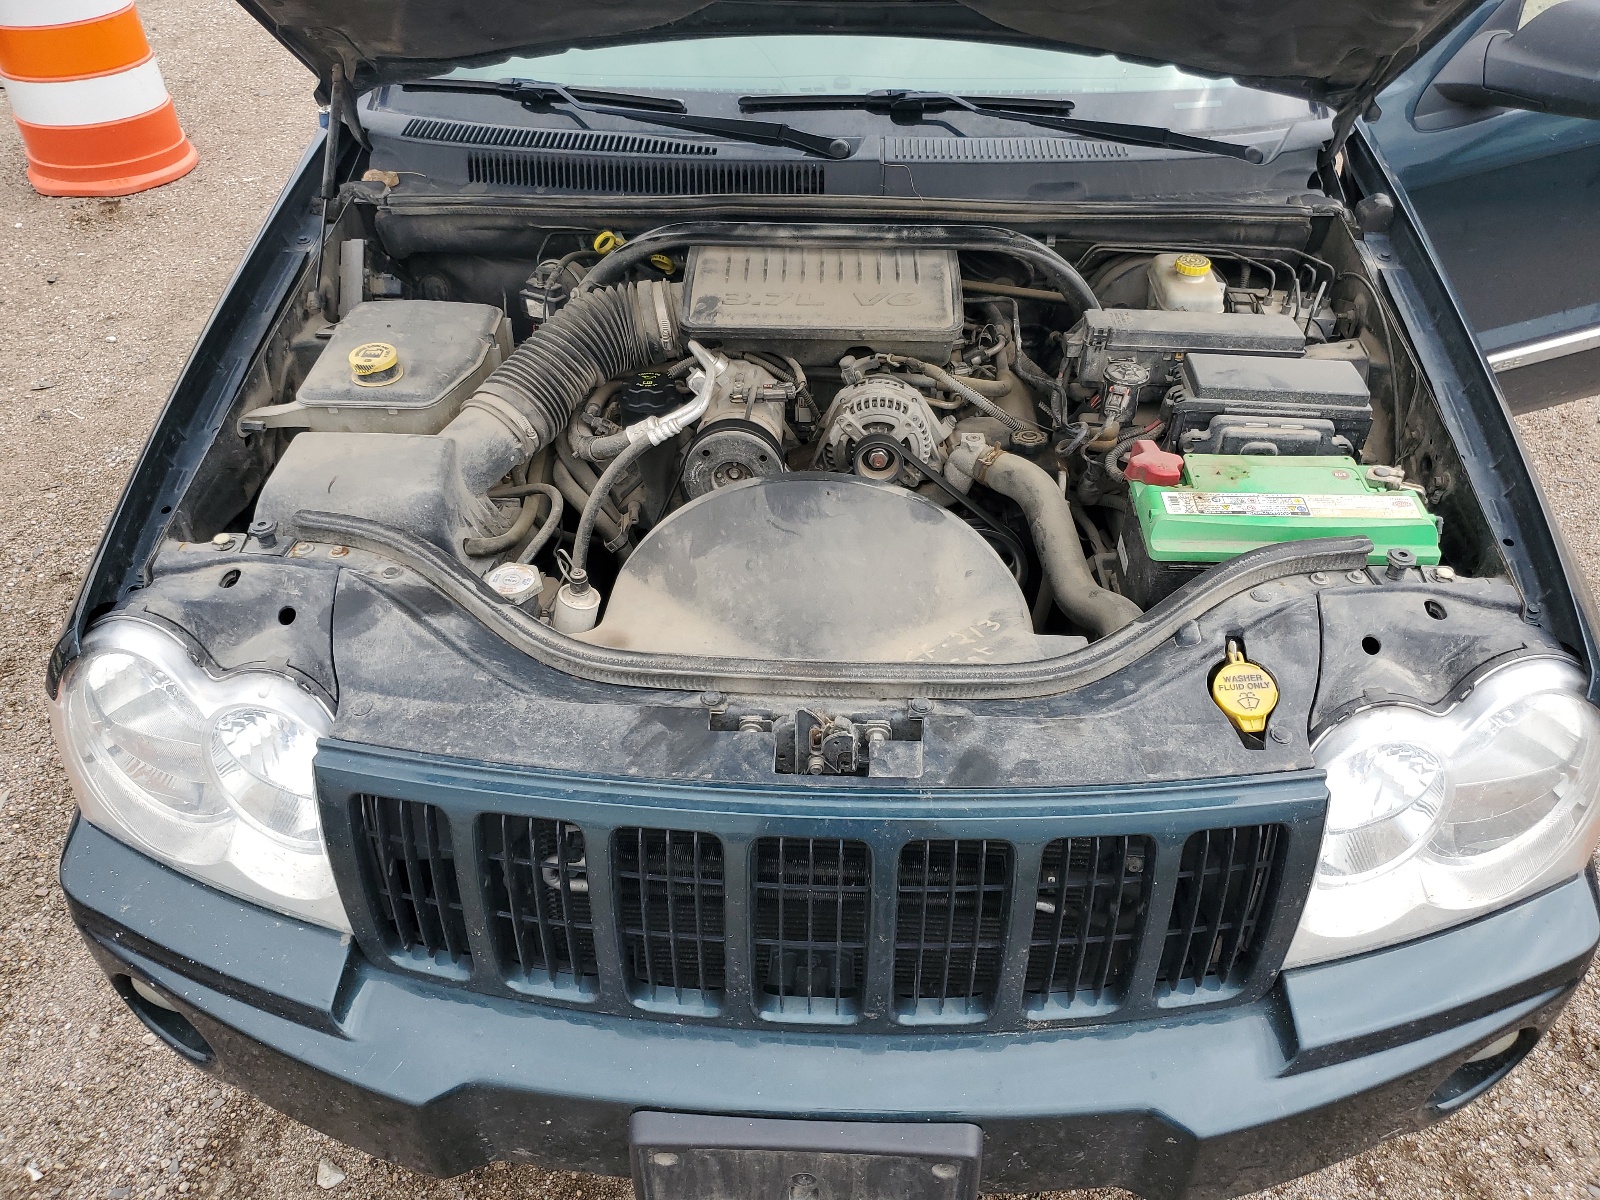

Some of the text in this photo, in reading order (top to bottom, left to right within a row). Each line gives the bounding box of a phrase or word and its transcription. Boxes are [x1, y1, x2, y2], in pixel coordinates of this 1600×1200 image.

[721, 292, 921, 307] 3.7L V6
[1222, 674, 1263, 683] WASHER
[1218, 681, 1270, 691] FLUID ONLY
